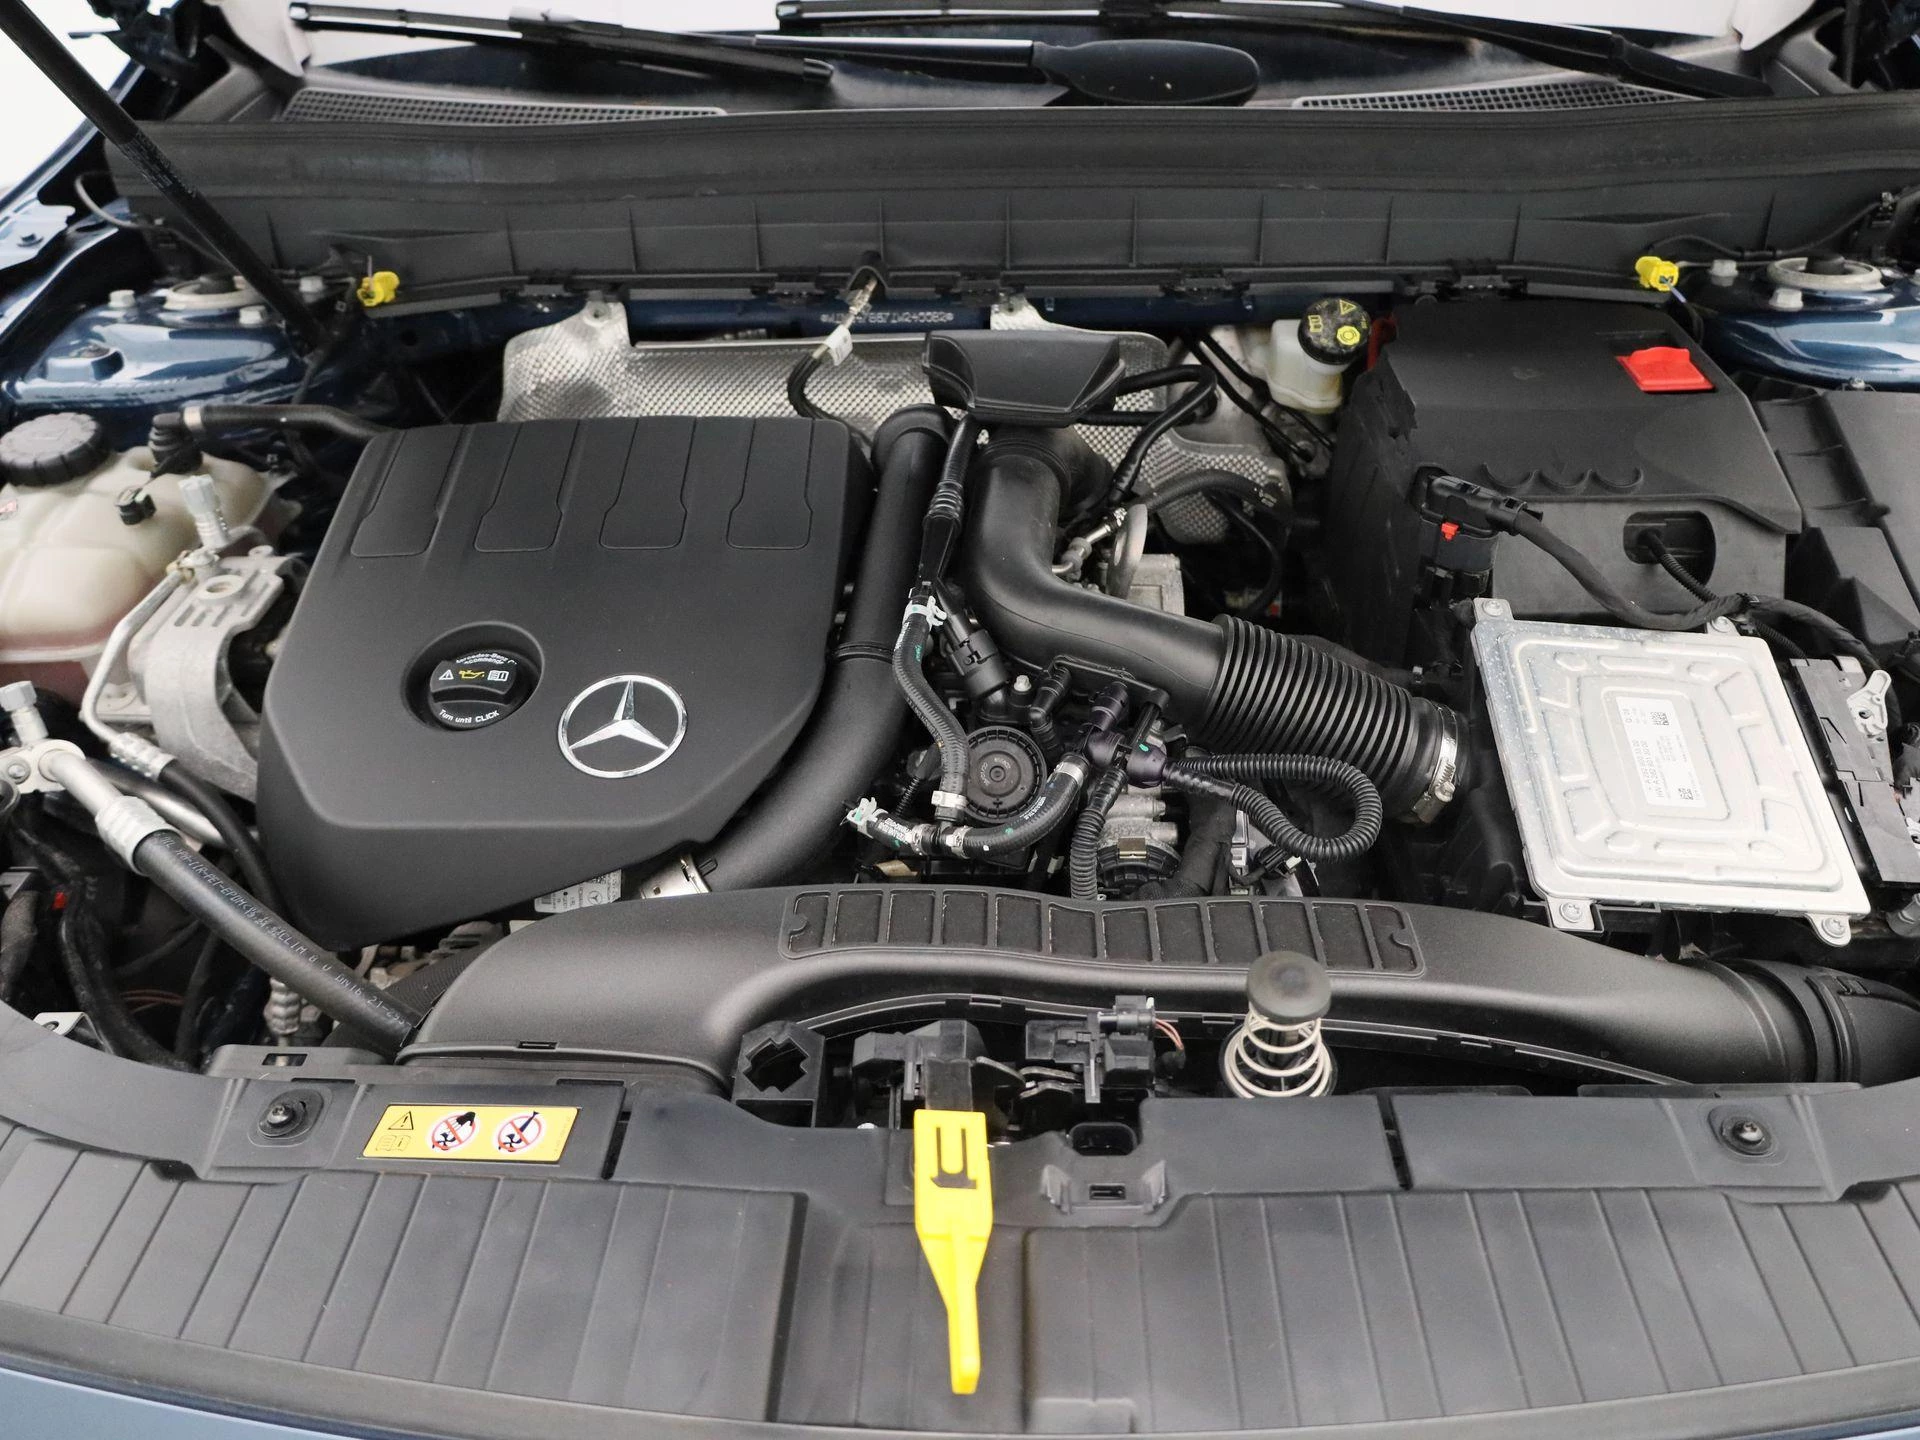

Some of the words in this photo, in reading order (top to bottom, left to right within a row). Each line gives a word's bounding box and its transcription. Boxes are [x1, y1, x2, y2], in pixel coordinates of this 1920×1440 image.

[439, 708, 454, 721] Turn
[455, 716, 473, 724] until
[475, 709, 500, 723] CLICK
